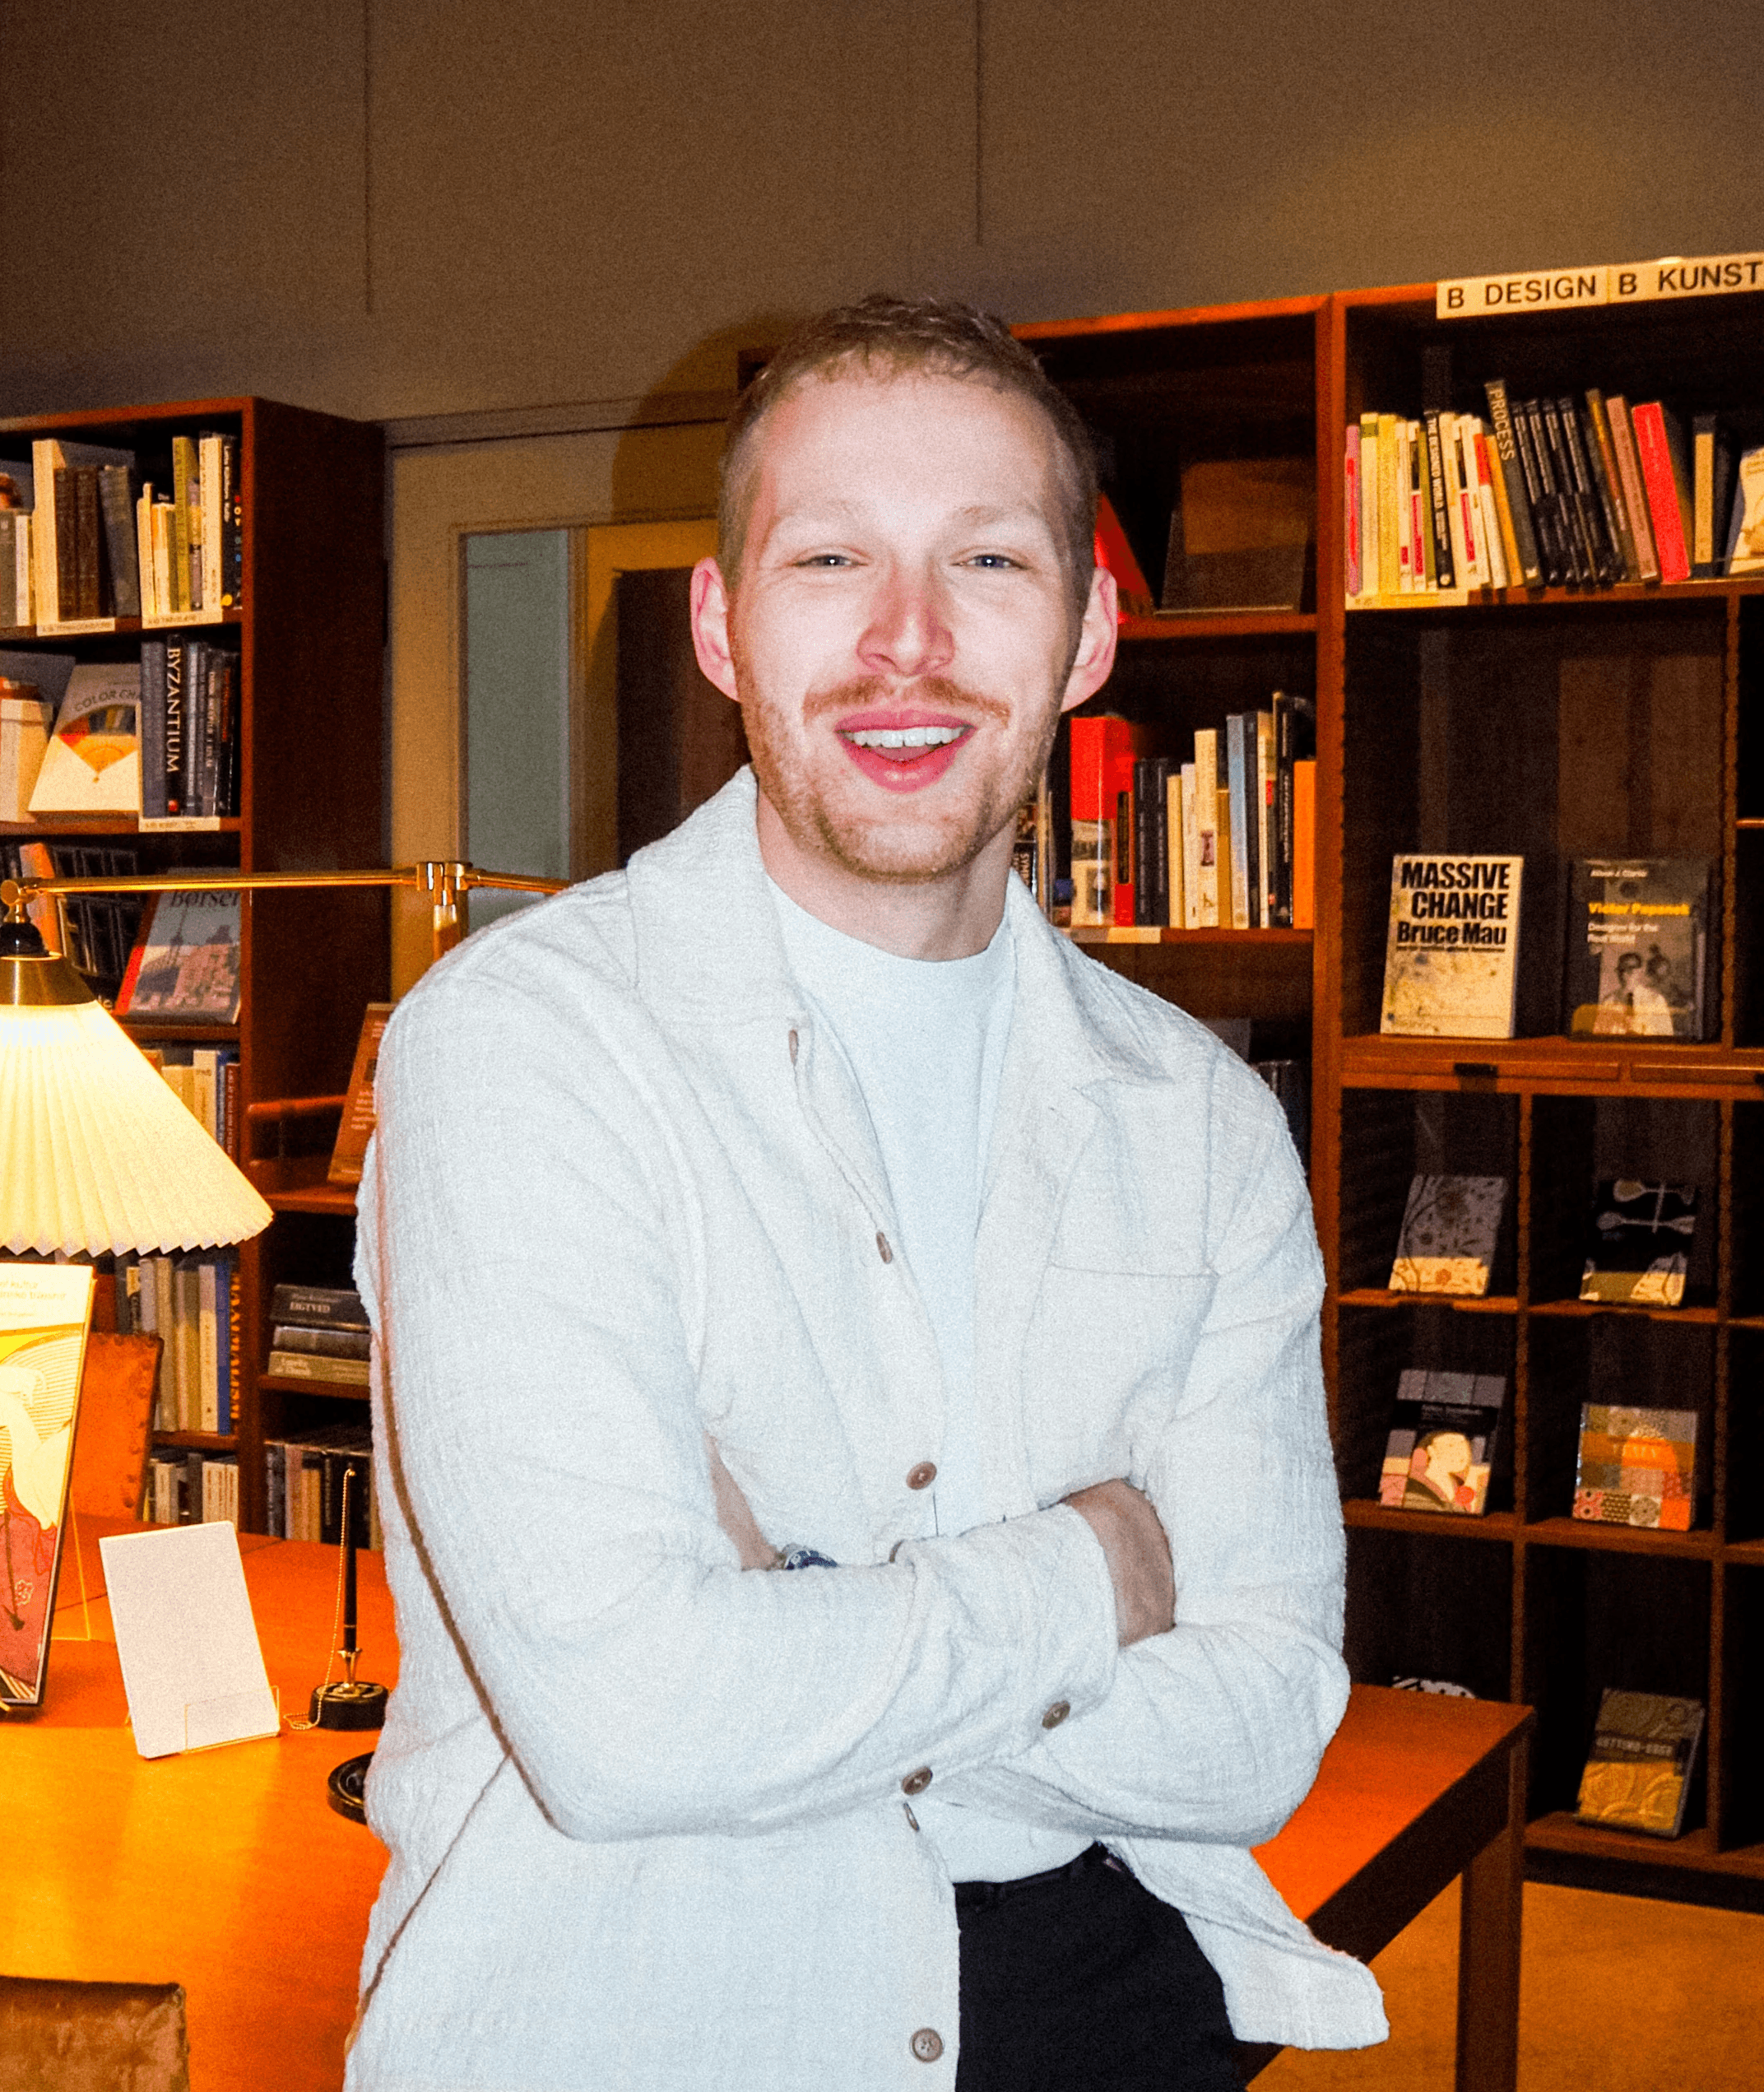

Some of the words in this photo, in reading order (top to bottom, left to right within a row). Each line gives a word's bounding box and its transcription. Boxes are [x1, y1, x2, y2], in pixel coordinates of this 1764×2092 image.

[1446, 287, 1465, 309] B
[1484, 275, 1596, 306] DESIGN
[1618, 272, 1637, 295] B
[1657, 261, 1764, 292] KUNST
[1488, 386, 1516, 461] PROCESS
[75, 690, 117, 712] COLOR
[167, 648, 181, 773] BYZANTIUM
[1401, 862, 1511, 890] MASSIVE
[1411, 891, 1508, 919] CHANGE
[1397, 920, 1460, 944] Bruce
[1462, 922, 1507, 945] Mau
